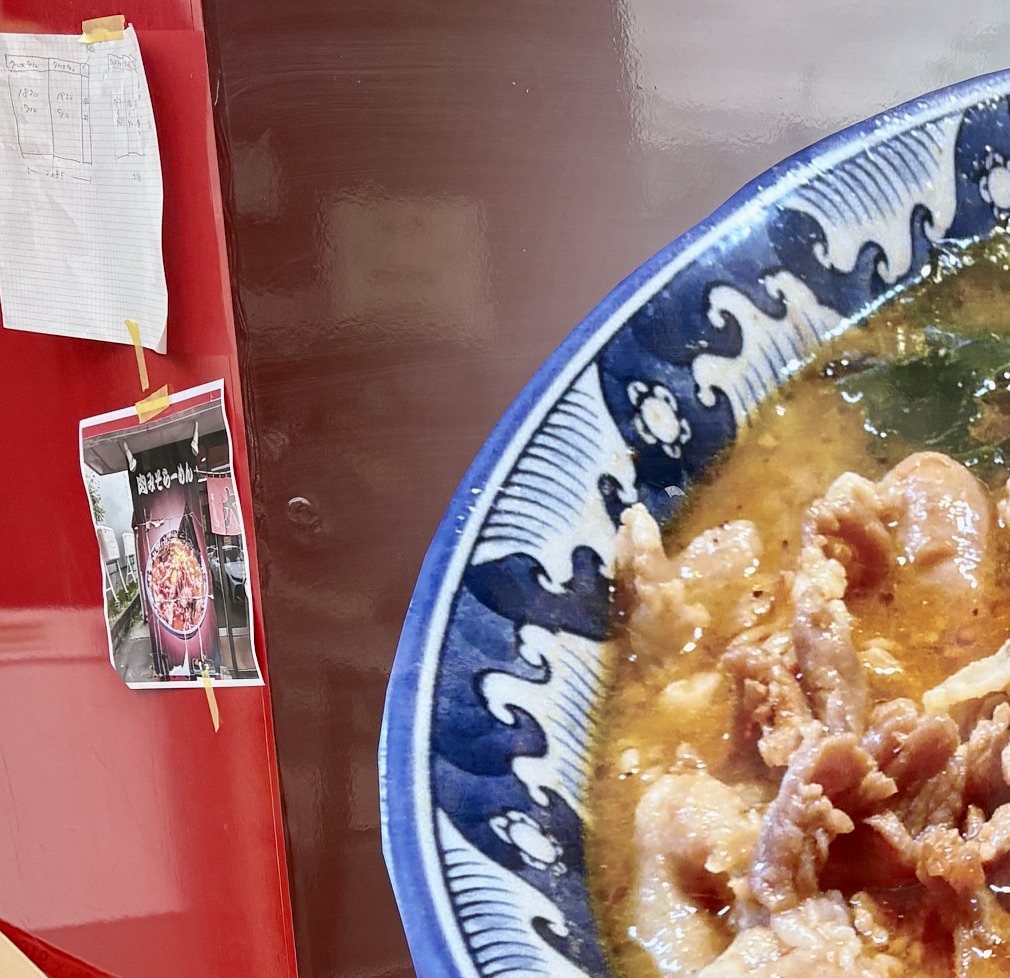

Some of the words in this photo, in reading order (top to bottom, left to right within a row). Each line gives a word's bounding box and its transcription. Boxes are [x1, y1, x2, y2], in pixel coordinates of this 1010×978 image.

[136, 462, 194, 496] 肉みそらーめん
